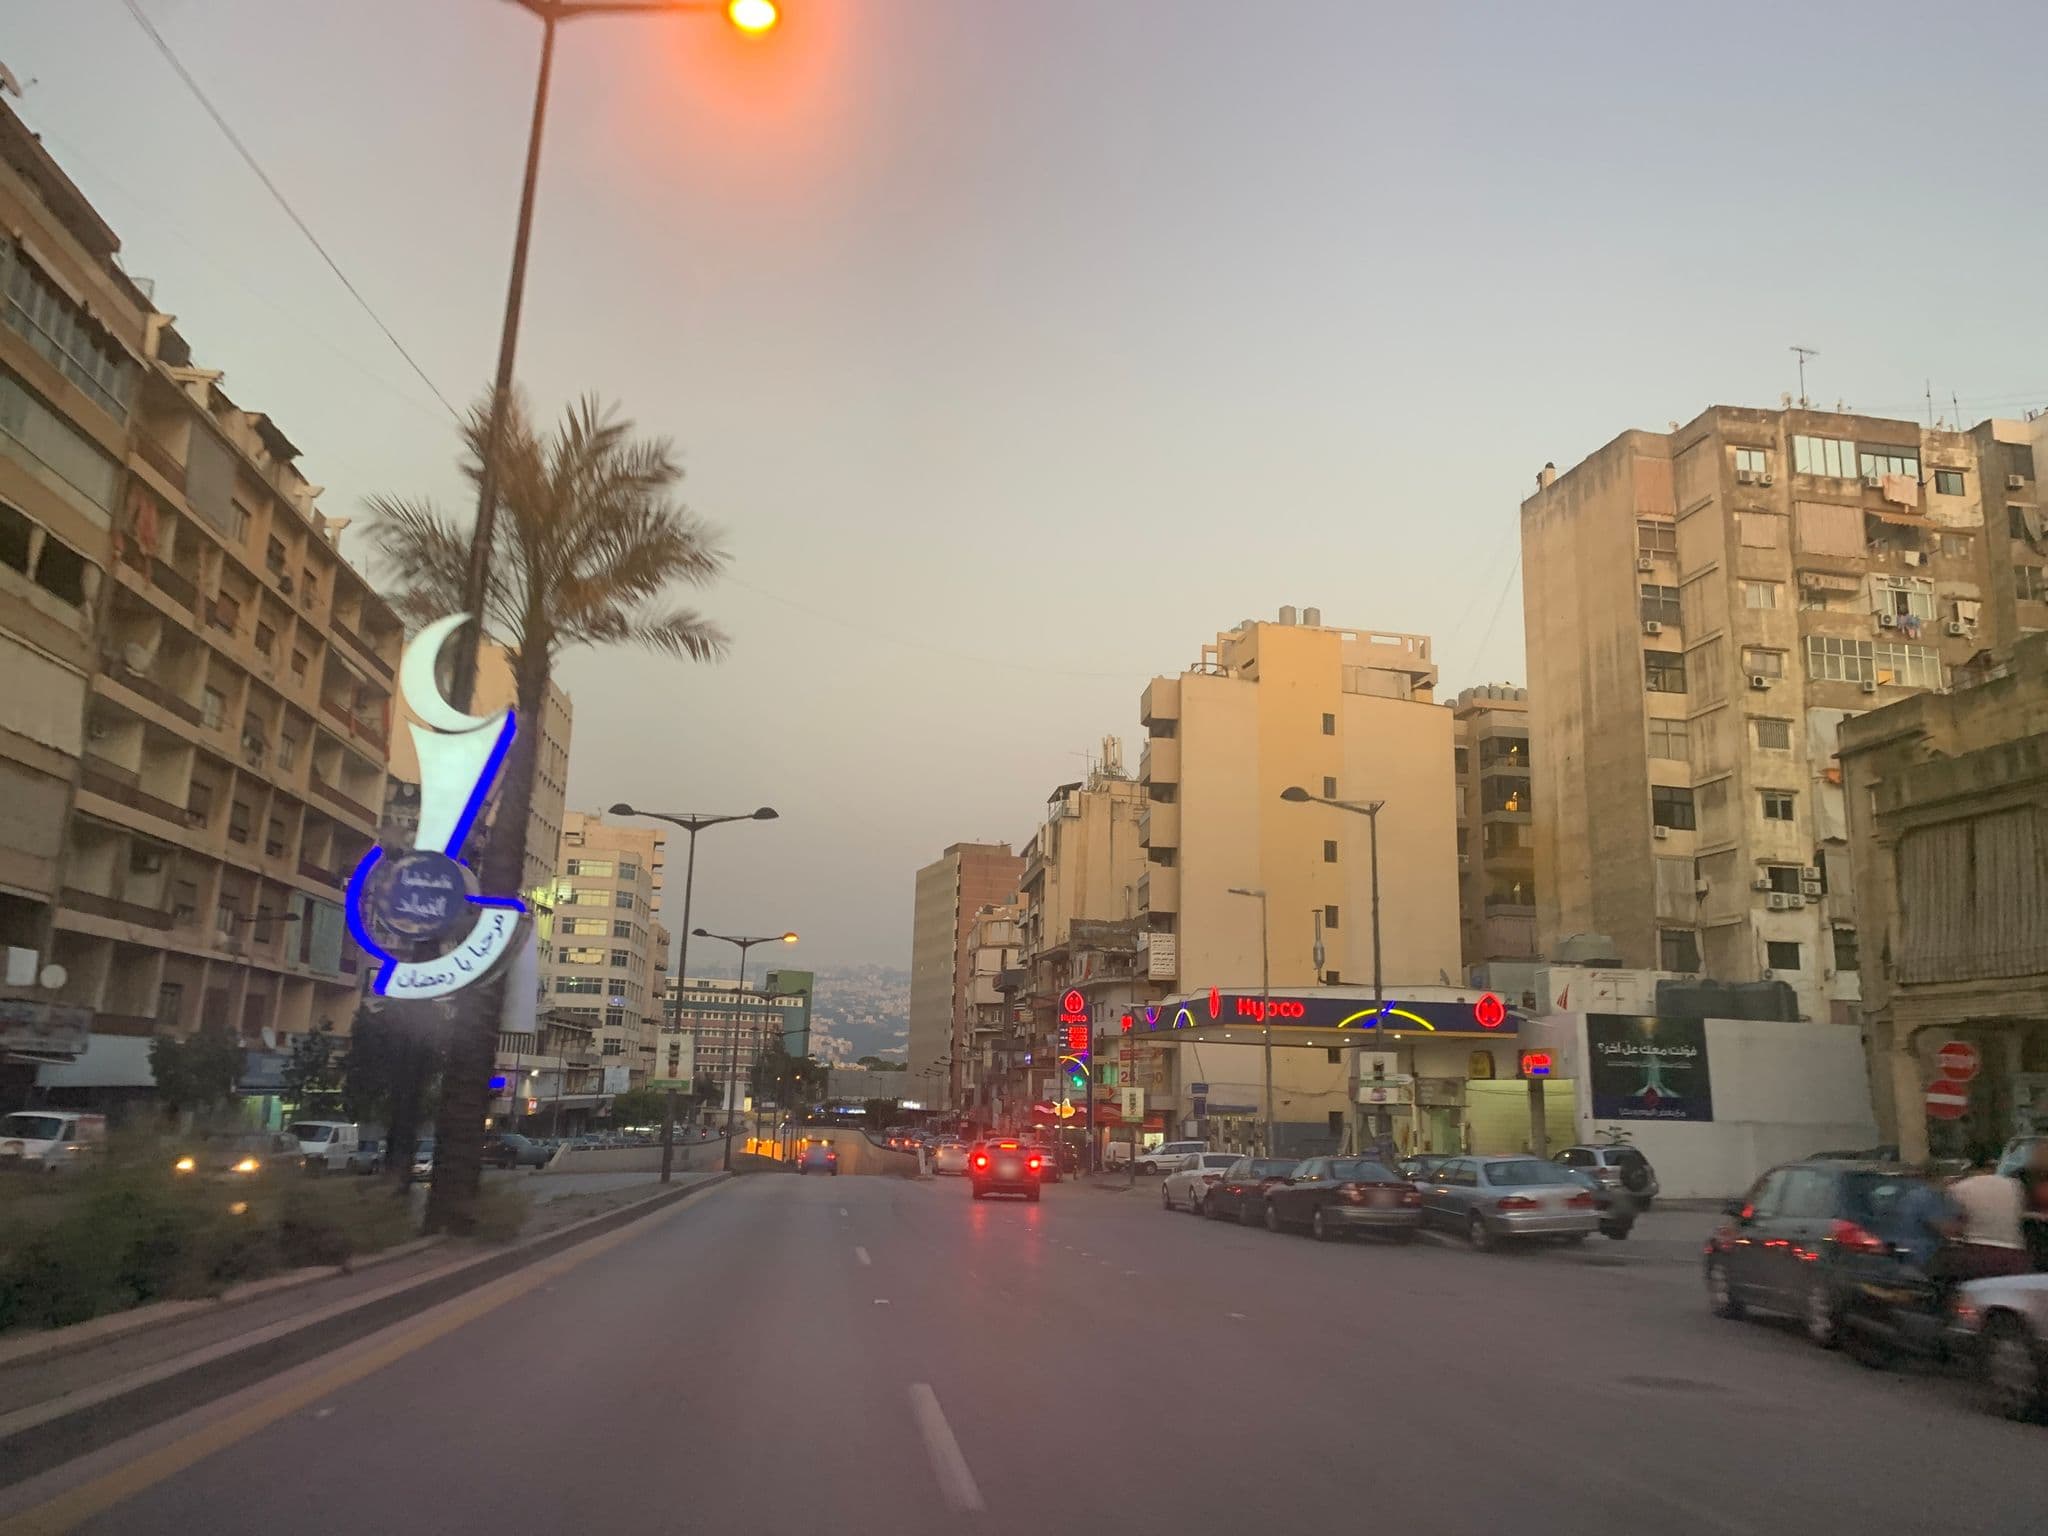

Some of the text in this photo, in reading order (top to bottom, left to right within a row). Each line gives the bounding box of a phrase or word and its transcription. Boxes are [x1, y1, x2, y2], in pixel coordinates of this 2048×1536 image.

[396, 914, 504, 989] مرحبا يا رمضان
[1060, 1014, 1088, 1024] Hypco
